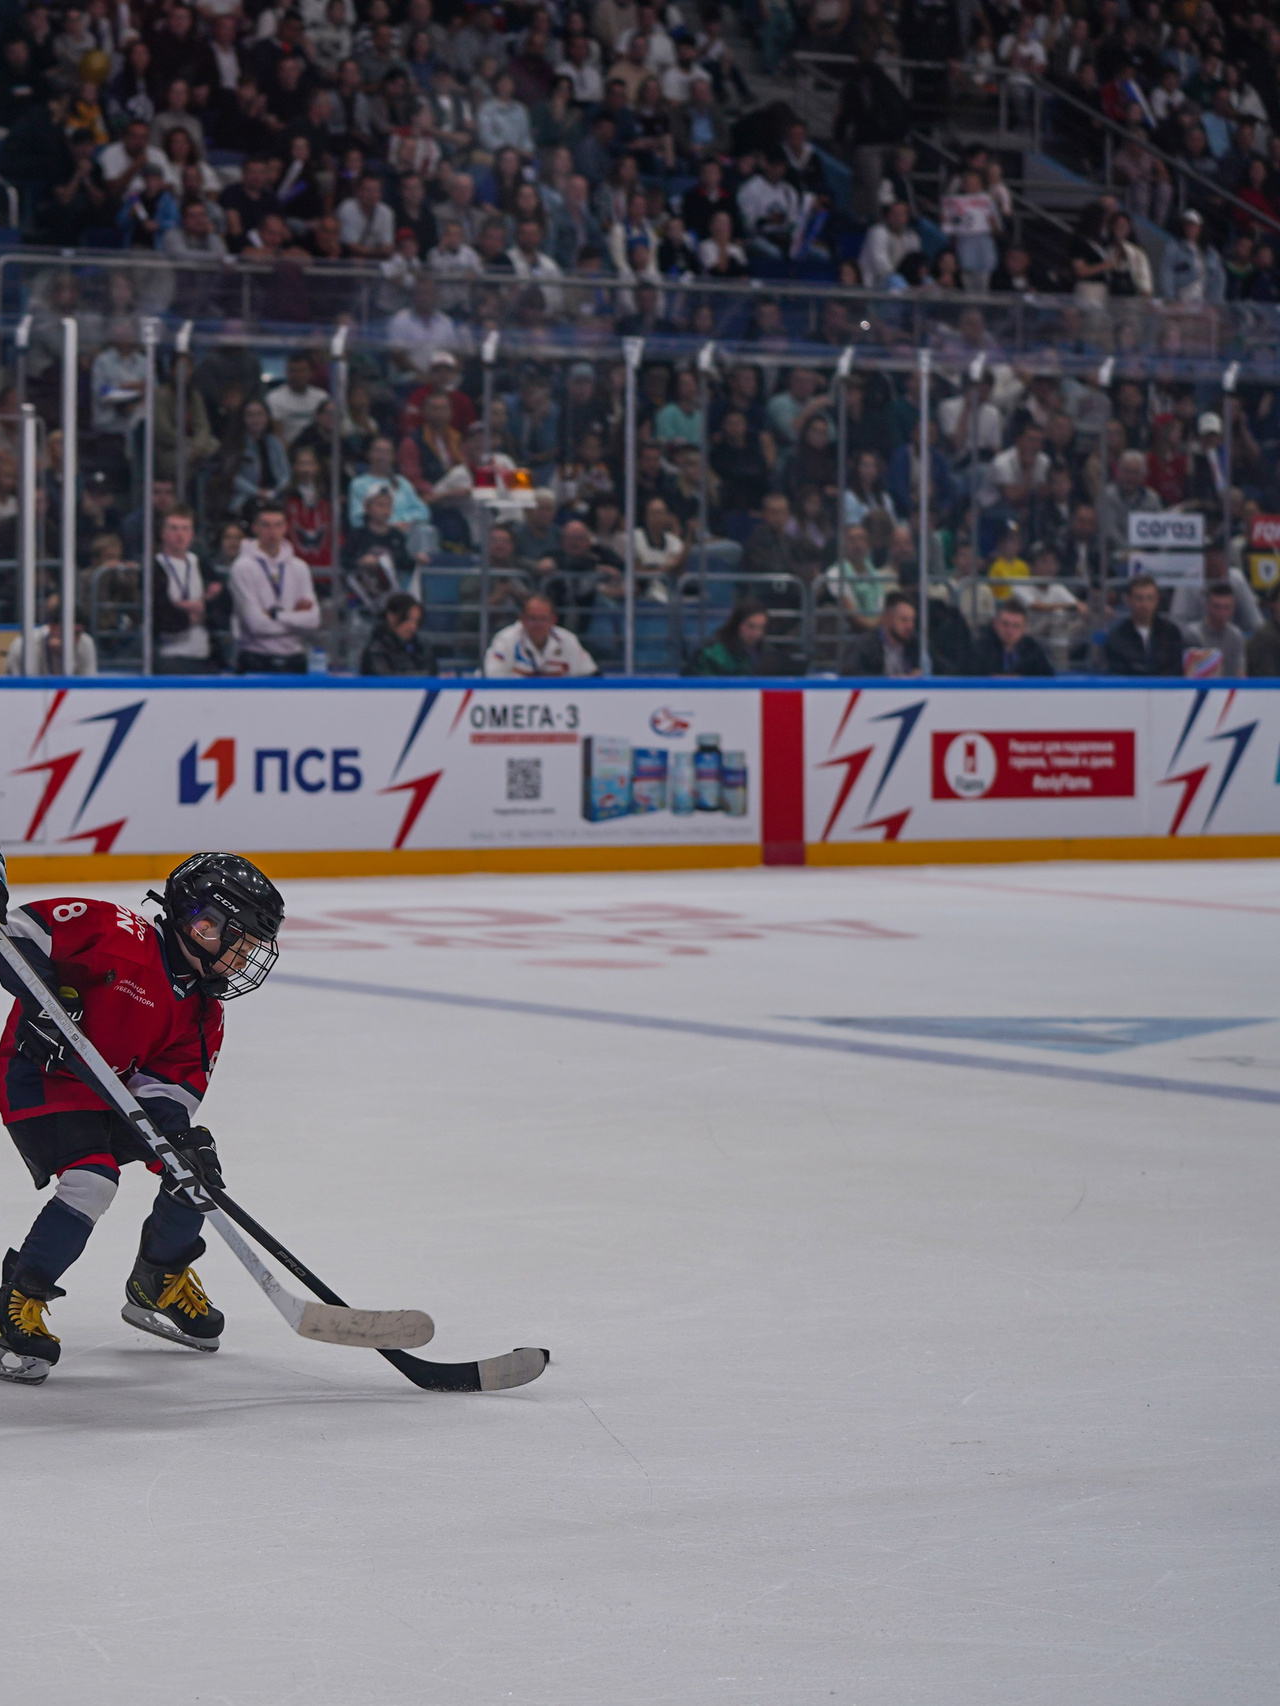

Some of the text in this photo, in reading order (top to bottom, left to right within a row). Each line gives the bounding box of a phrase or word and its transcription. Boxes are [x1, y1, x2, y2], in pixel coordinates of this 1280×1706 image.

[254, 747, 363, 793] ПСБ
[52, 902, 88, 922] 8
[213, 893, 240, 914] CCM
[128, 1109, 219, 1214] CCM
[277, 1250, 307, 1277] PRO
